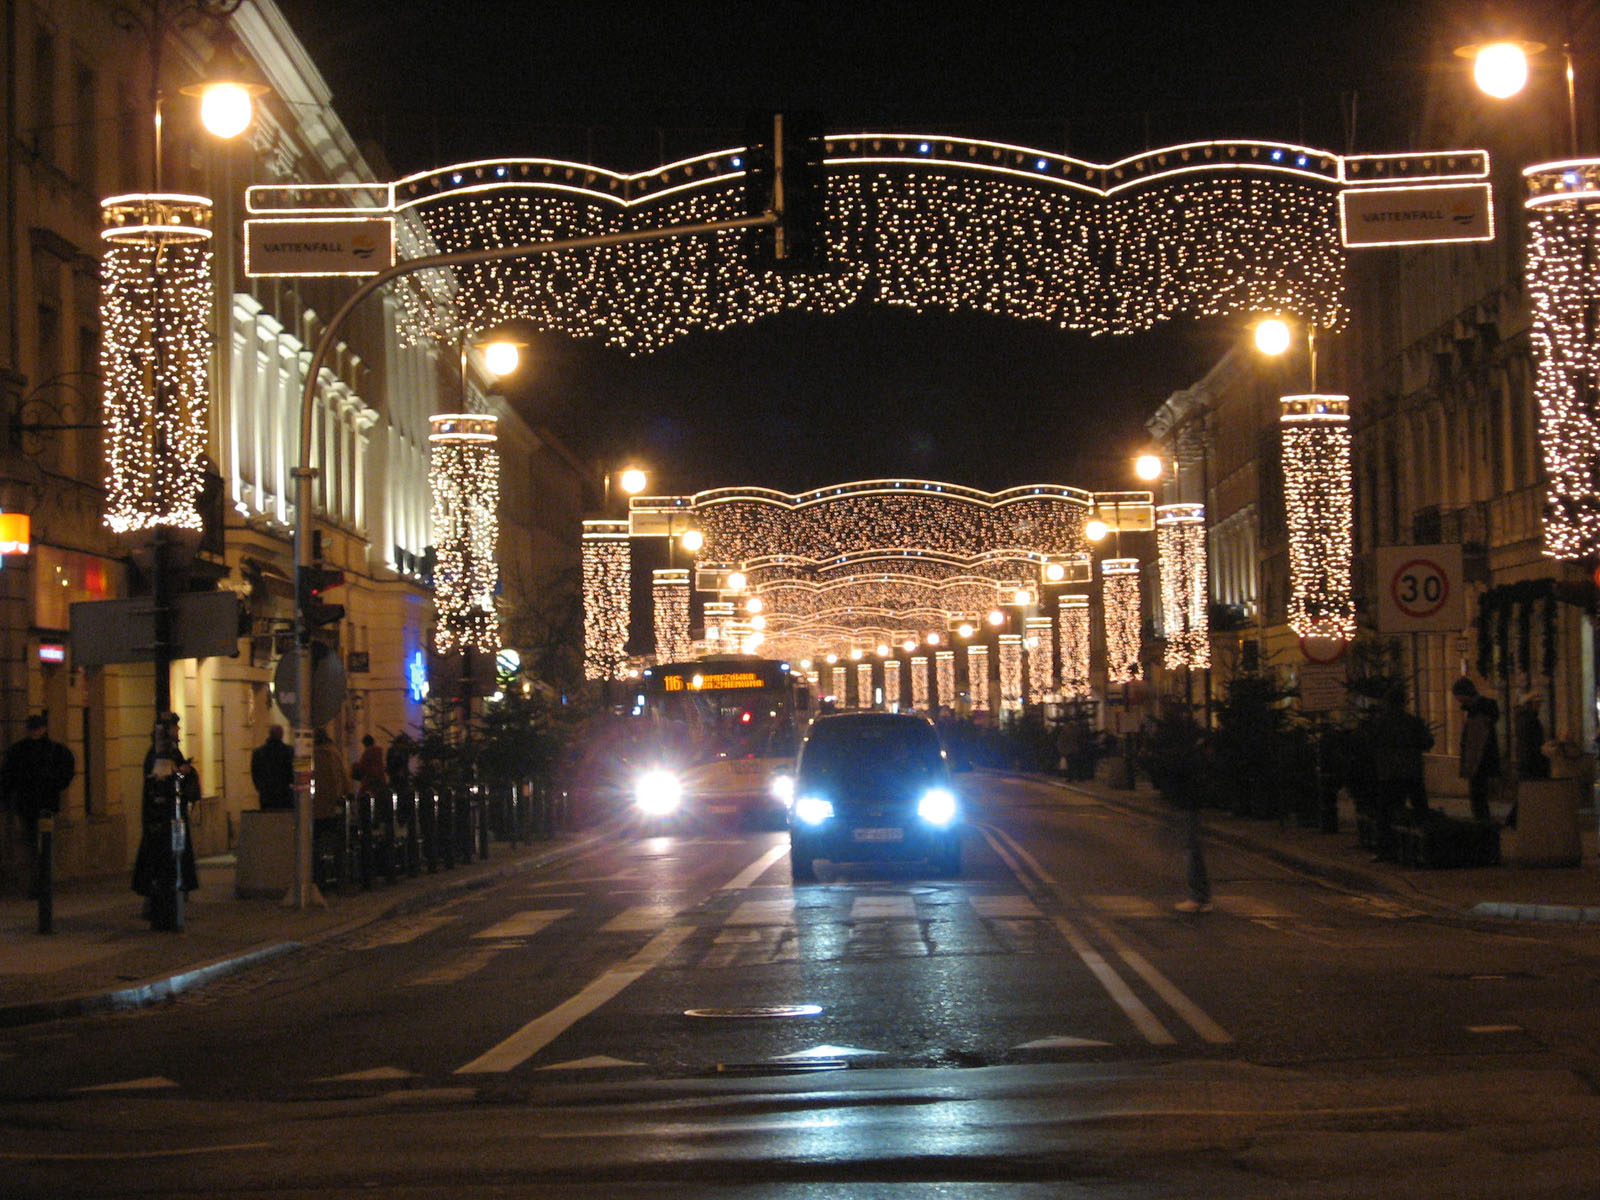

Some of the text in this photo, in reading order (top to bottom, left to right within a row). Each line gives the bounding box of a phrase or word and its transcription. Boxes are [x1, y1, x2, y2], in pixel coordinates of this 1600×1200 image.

[1362, 209, 1444, 222] VATTENFALL
[263, 241, 344, 253] VATTENFALL
[1400, 575, 1442, 602] 30
[664, 674, 683, 691] 116
